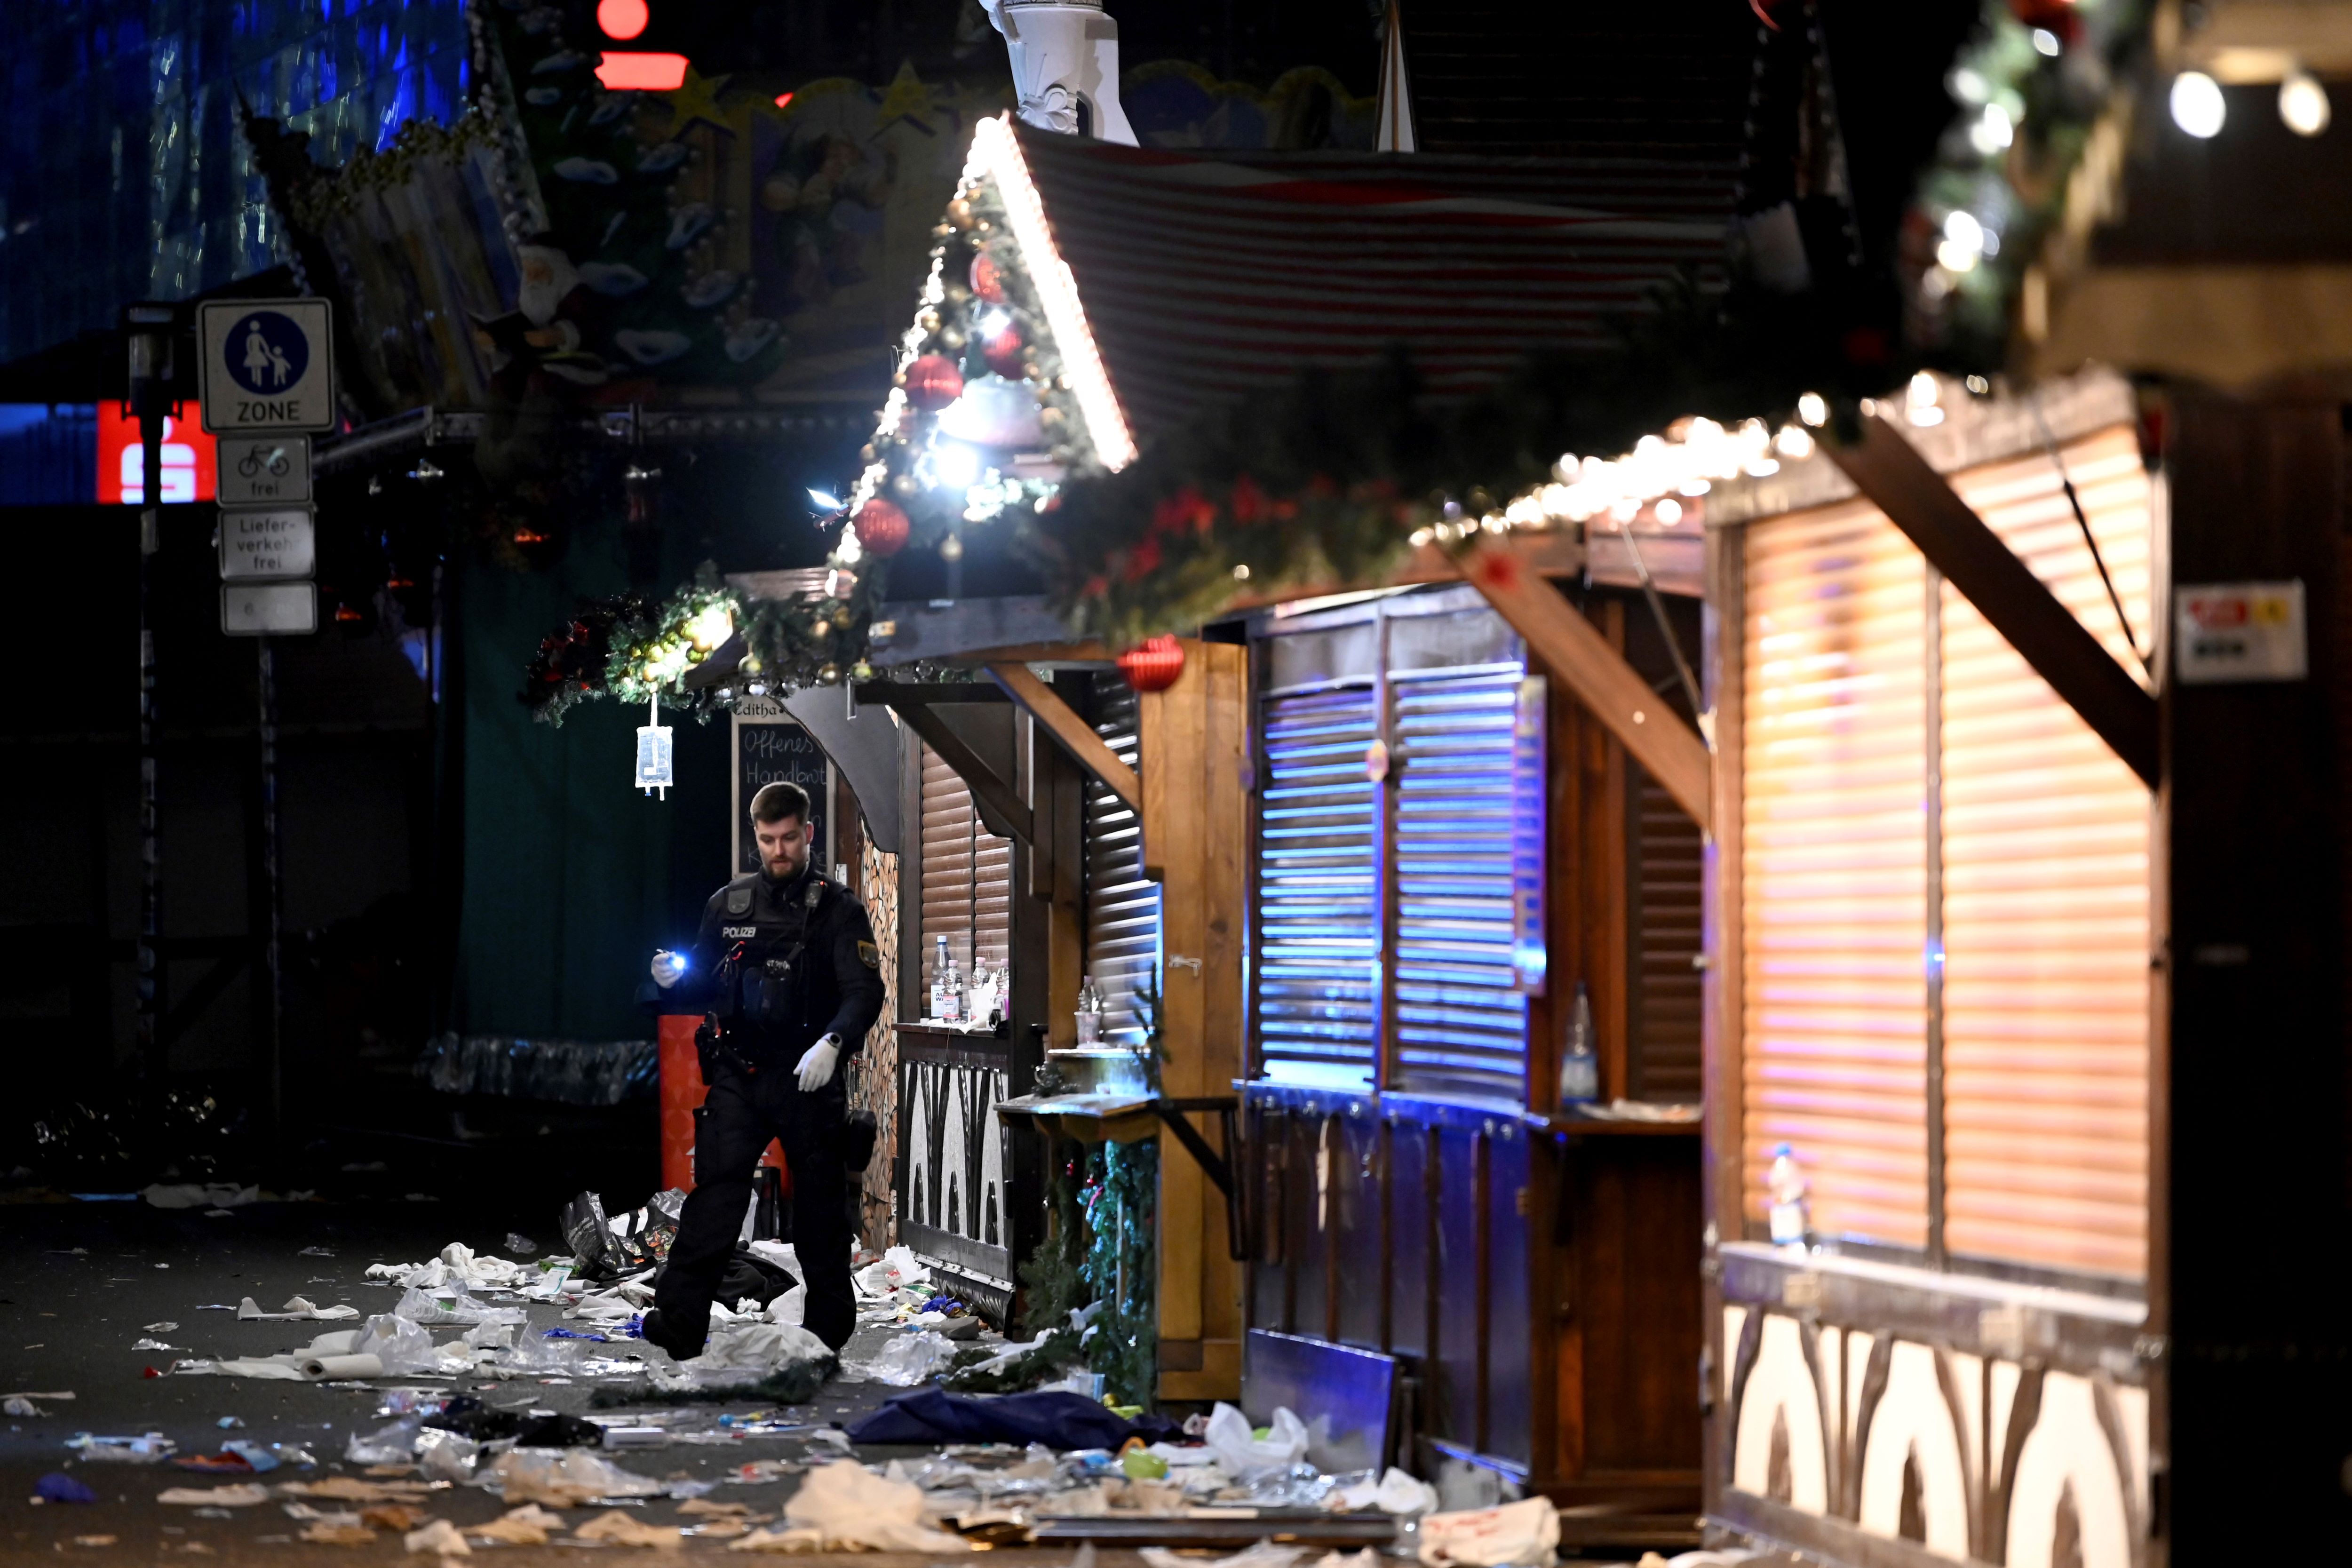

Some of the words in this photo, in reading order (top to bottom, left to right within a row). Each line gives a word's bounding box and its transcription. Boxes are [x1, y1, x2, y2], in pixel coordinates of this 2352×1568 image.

[238, 401, 300, 422] ZONE
[252, 480, 279, 495] frei
[240, 518, 295, 533] Liefer-
[237, 538, 296, 552] verkeh
[254, 555, 281, 569] frei
[745, 730, 813, 758] Offenes
[747, 760, 826, 785] Handbrot
[723, 927, 756, 938] POLIZEI
